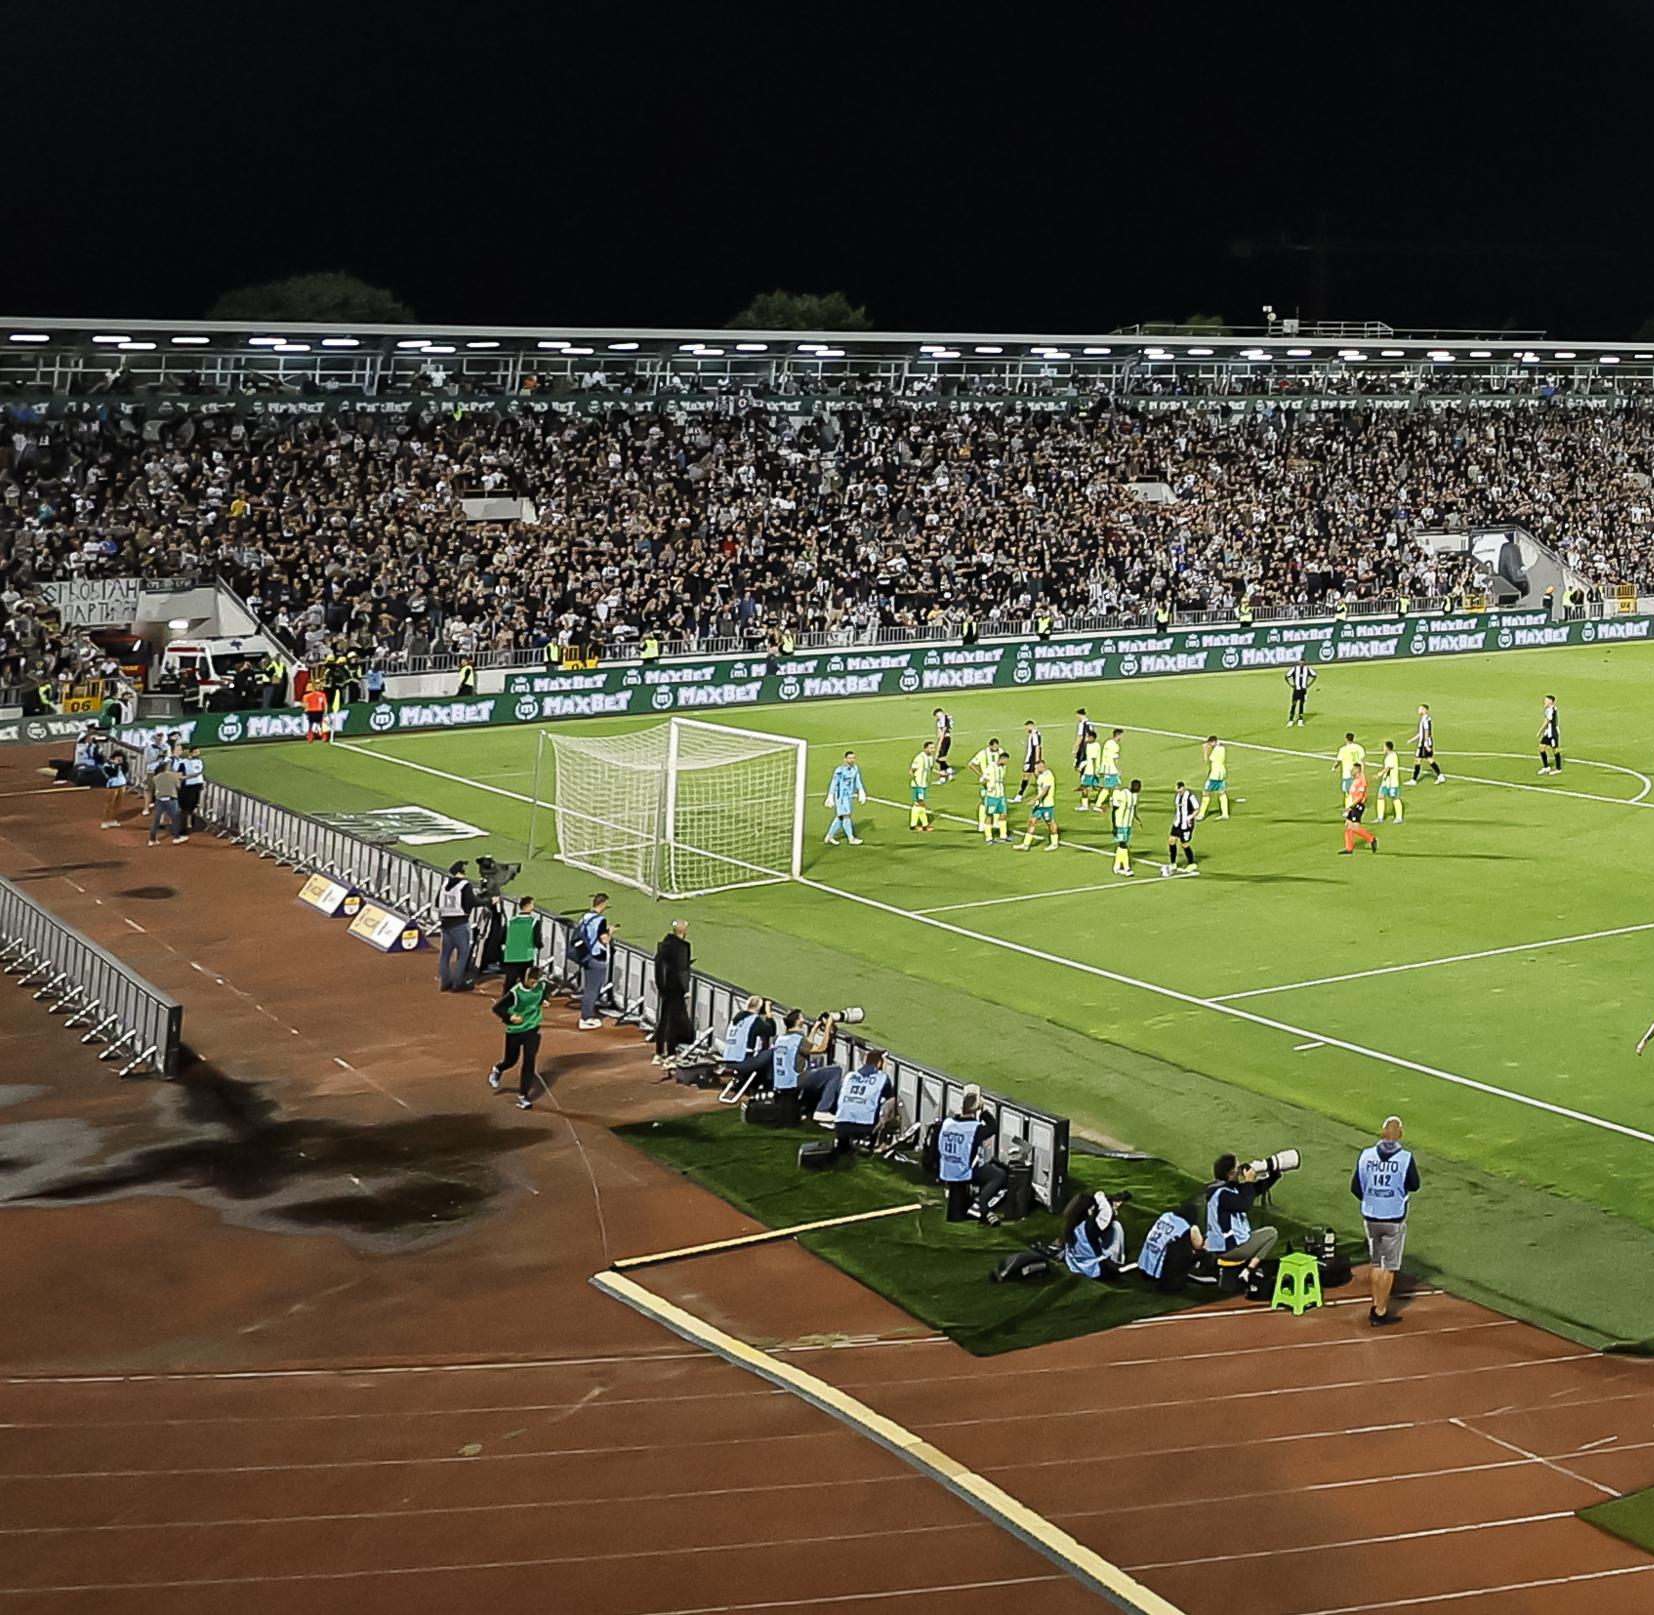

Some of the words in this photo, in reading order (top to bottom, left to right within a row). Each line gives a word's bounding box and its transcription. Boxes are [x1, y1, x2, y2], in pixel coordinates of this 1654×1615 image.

[1430, 617, 1478, 632] MAXBET
[1502, 613, 1547, 627] MAXBET
[1282, 627, 1334, 642] MAXBET
[1356, 622, 1405, 637] MAXBET
[1515, 626, 1570, 645] MAXBET
[1598, 620, 1649, 639] MAXBET
[1118, 637, 1174, 653] MAXBET
[1202, 632, 1255, 647] MAXBET
[1337, 638, 1399, 658] MAXBET
[1428, 632, 1486, 652] MAXBET
[943, 648, 1004, 665] MAXBET
[1035, 642, 1093, 659] MAXBET
[1241, 645, 1305, 665] MAXBET
[847, 653, 911, 670] MAXBET
[1035, 658, 1106, 680] MAXBET
[1141, 651, 1207, 672] MAXBET
[533, 674, 608, 692] MAXBET
[645, 666, 716, 684] MAXBET
[922, 665, 998, 688] MAXBET
[803, 673, 883, 697] MAXBET
[542, 690, 633, 716] MAXBET
[677, 682, 762, 707] MAXBET
[400, 700, 495, 727] MAXBET
[1366, 1160, 1398, 1173] PHOTO
[1374, 1175, 1391, 1186] 142
